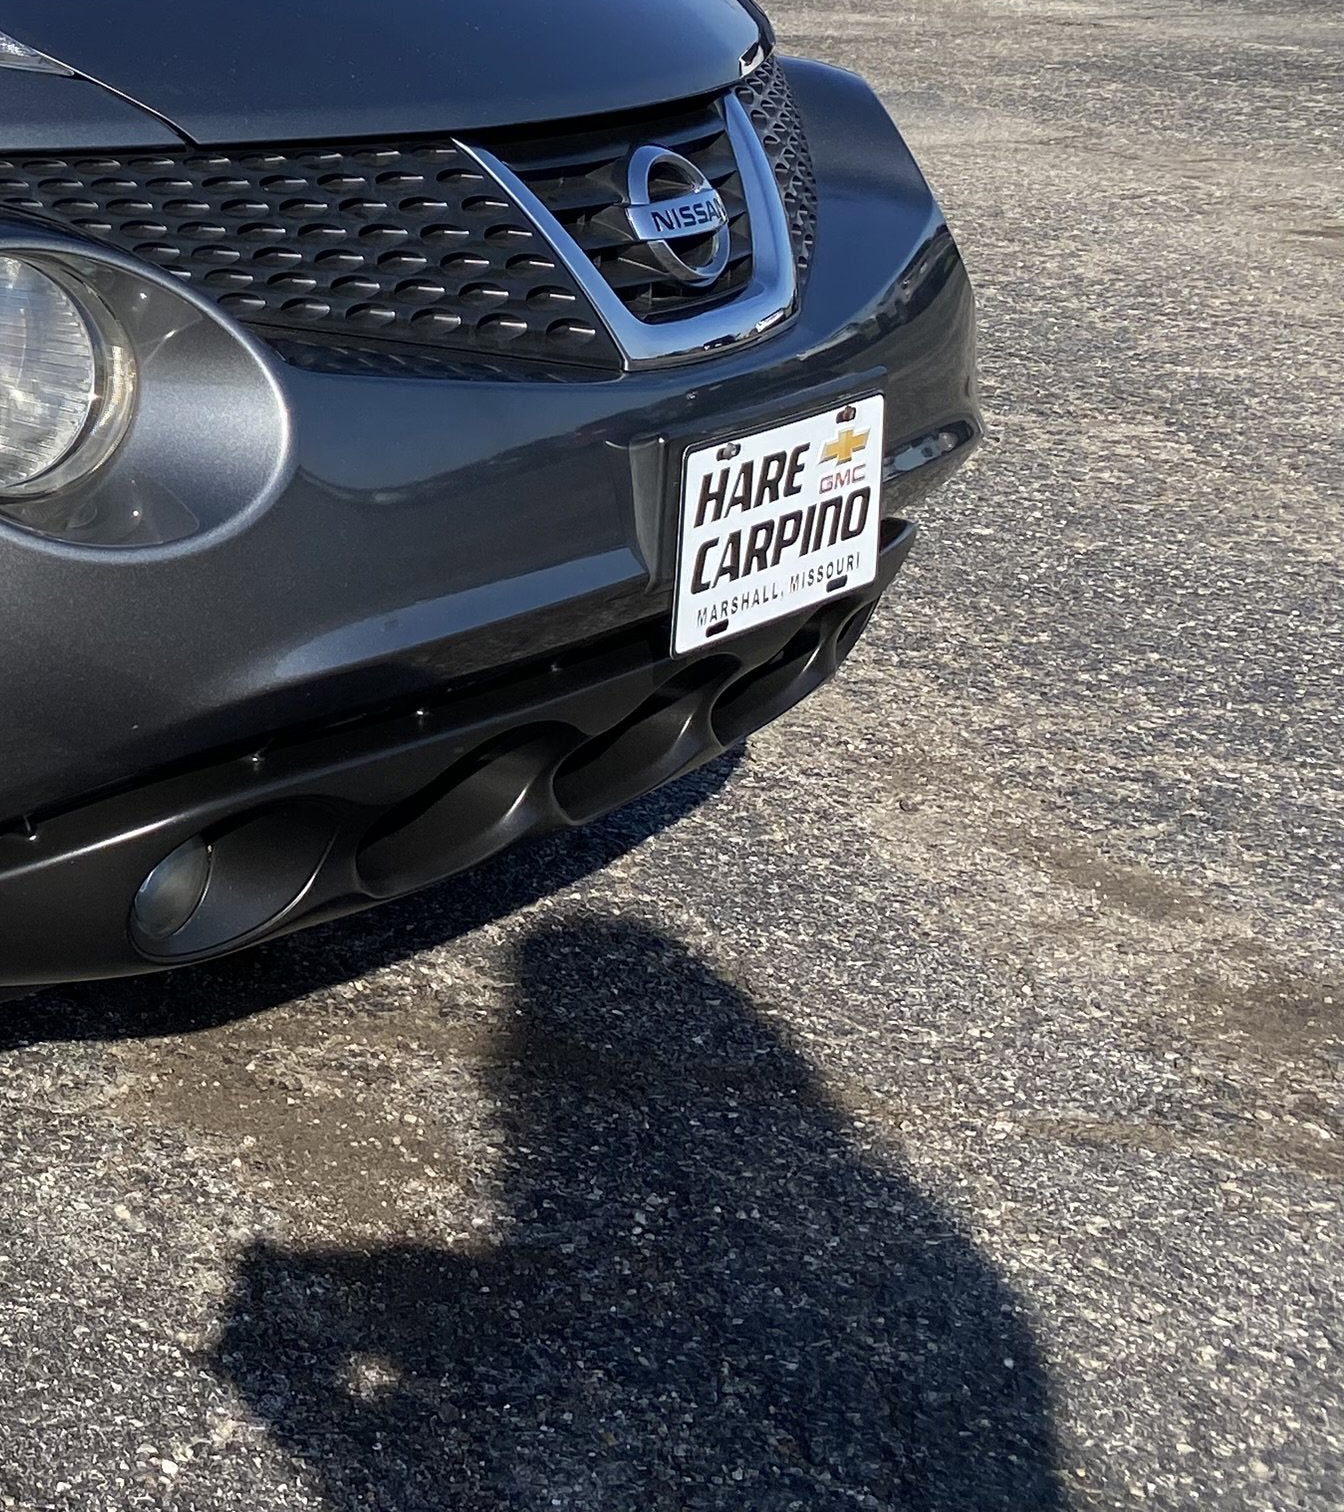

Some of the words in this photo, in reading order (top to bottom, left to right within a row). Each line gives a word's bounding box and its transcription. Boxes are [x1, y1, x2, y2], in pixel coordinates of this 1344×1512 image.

[650, 197, 727, 233] NISSAN
[693, 441, 811, 529] HARE
[818, 464, 867, 494] GMC
[690, 486, 872, 596] CARPINO
[696, 585, 785, 628] MARSHALL,
[789, 551, 861, 594] MISSOURI
